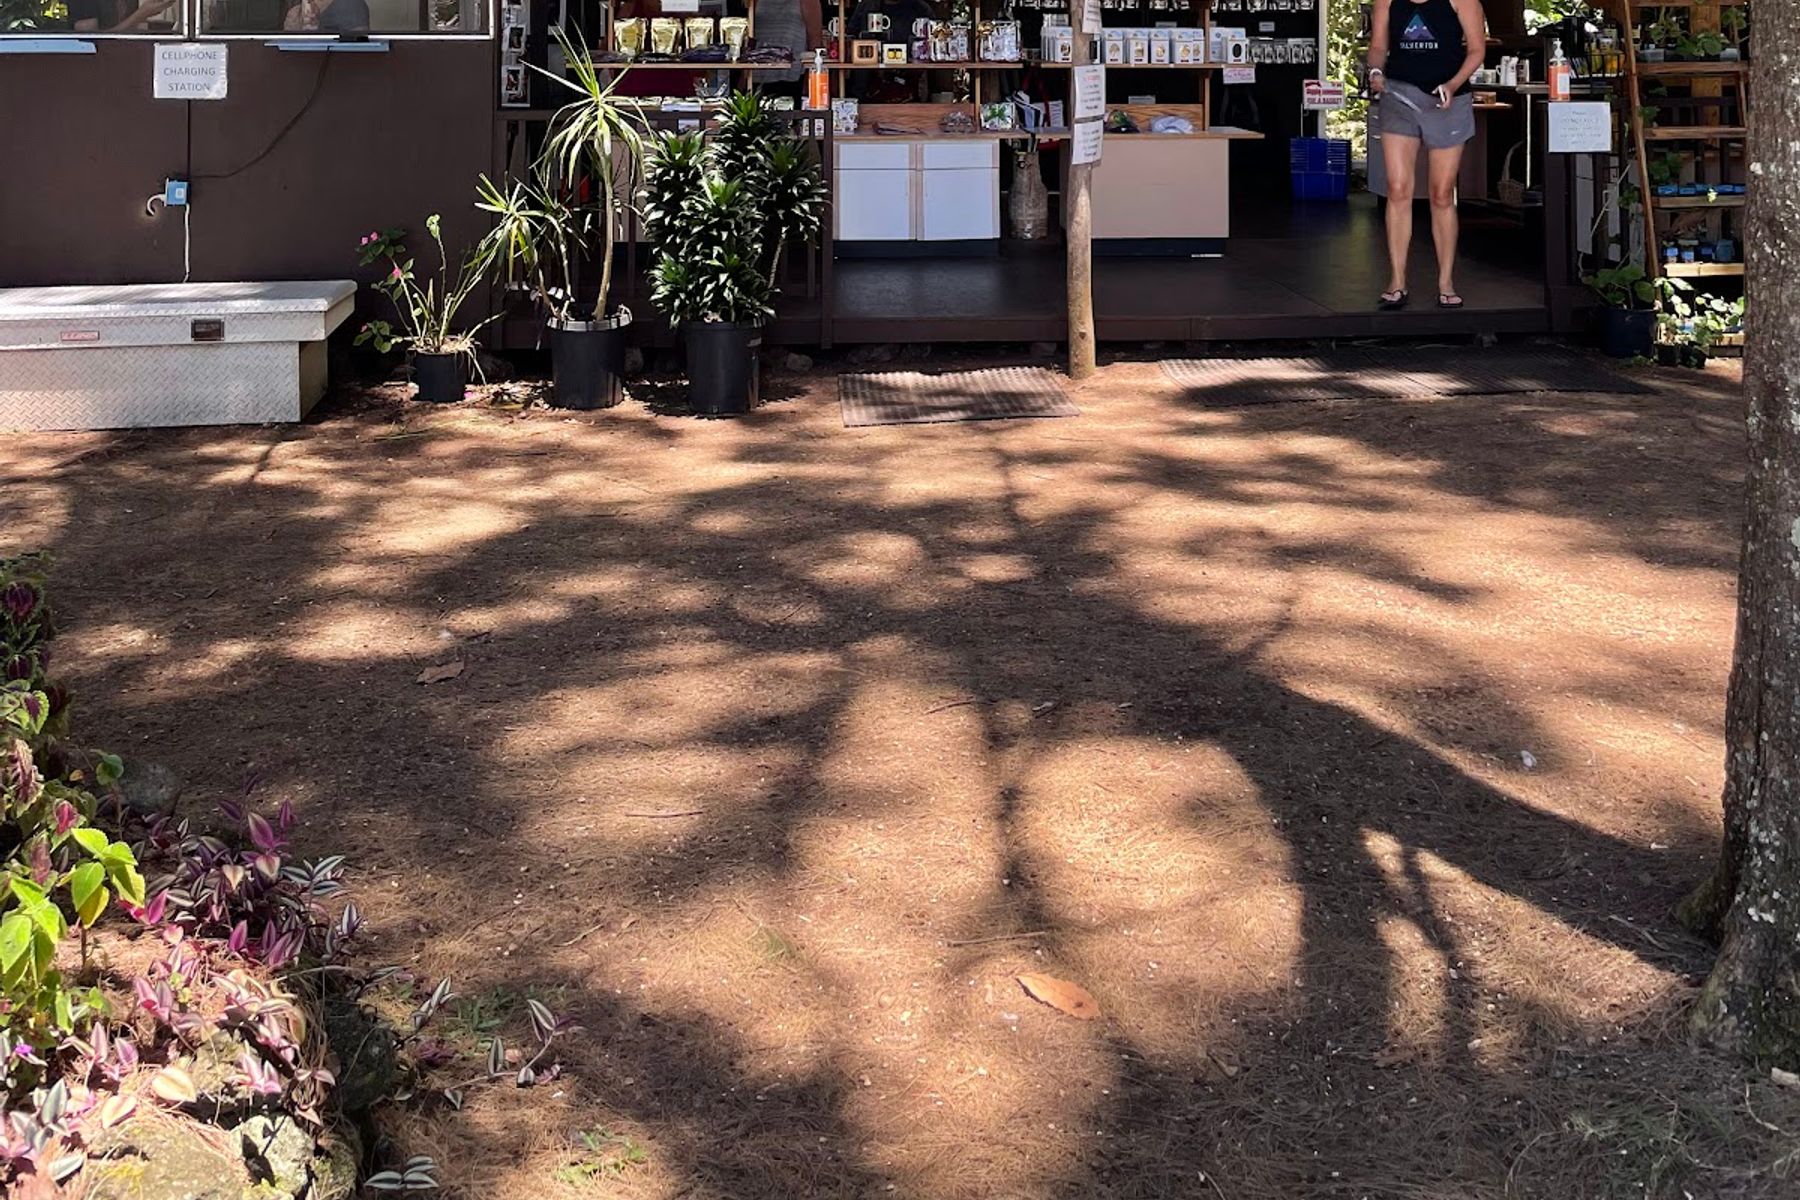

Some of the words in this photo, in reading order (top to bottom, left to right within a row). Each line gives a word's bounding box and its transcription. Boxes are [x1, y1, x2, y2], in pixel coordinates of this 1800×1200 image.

[161, 51, 217, 60] CELLPHONE
[163, 67, 216, 76] CHARGING
[168, 82, 210, 92] STATION
